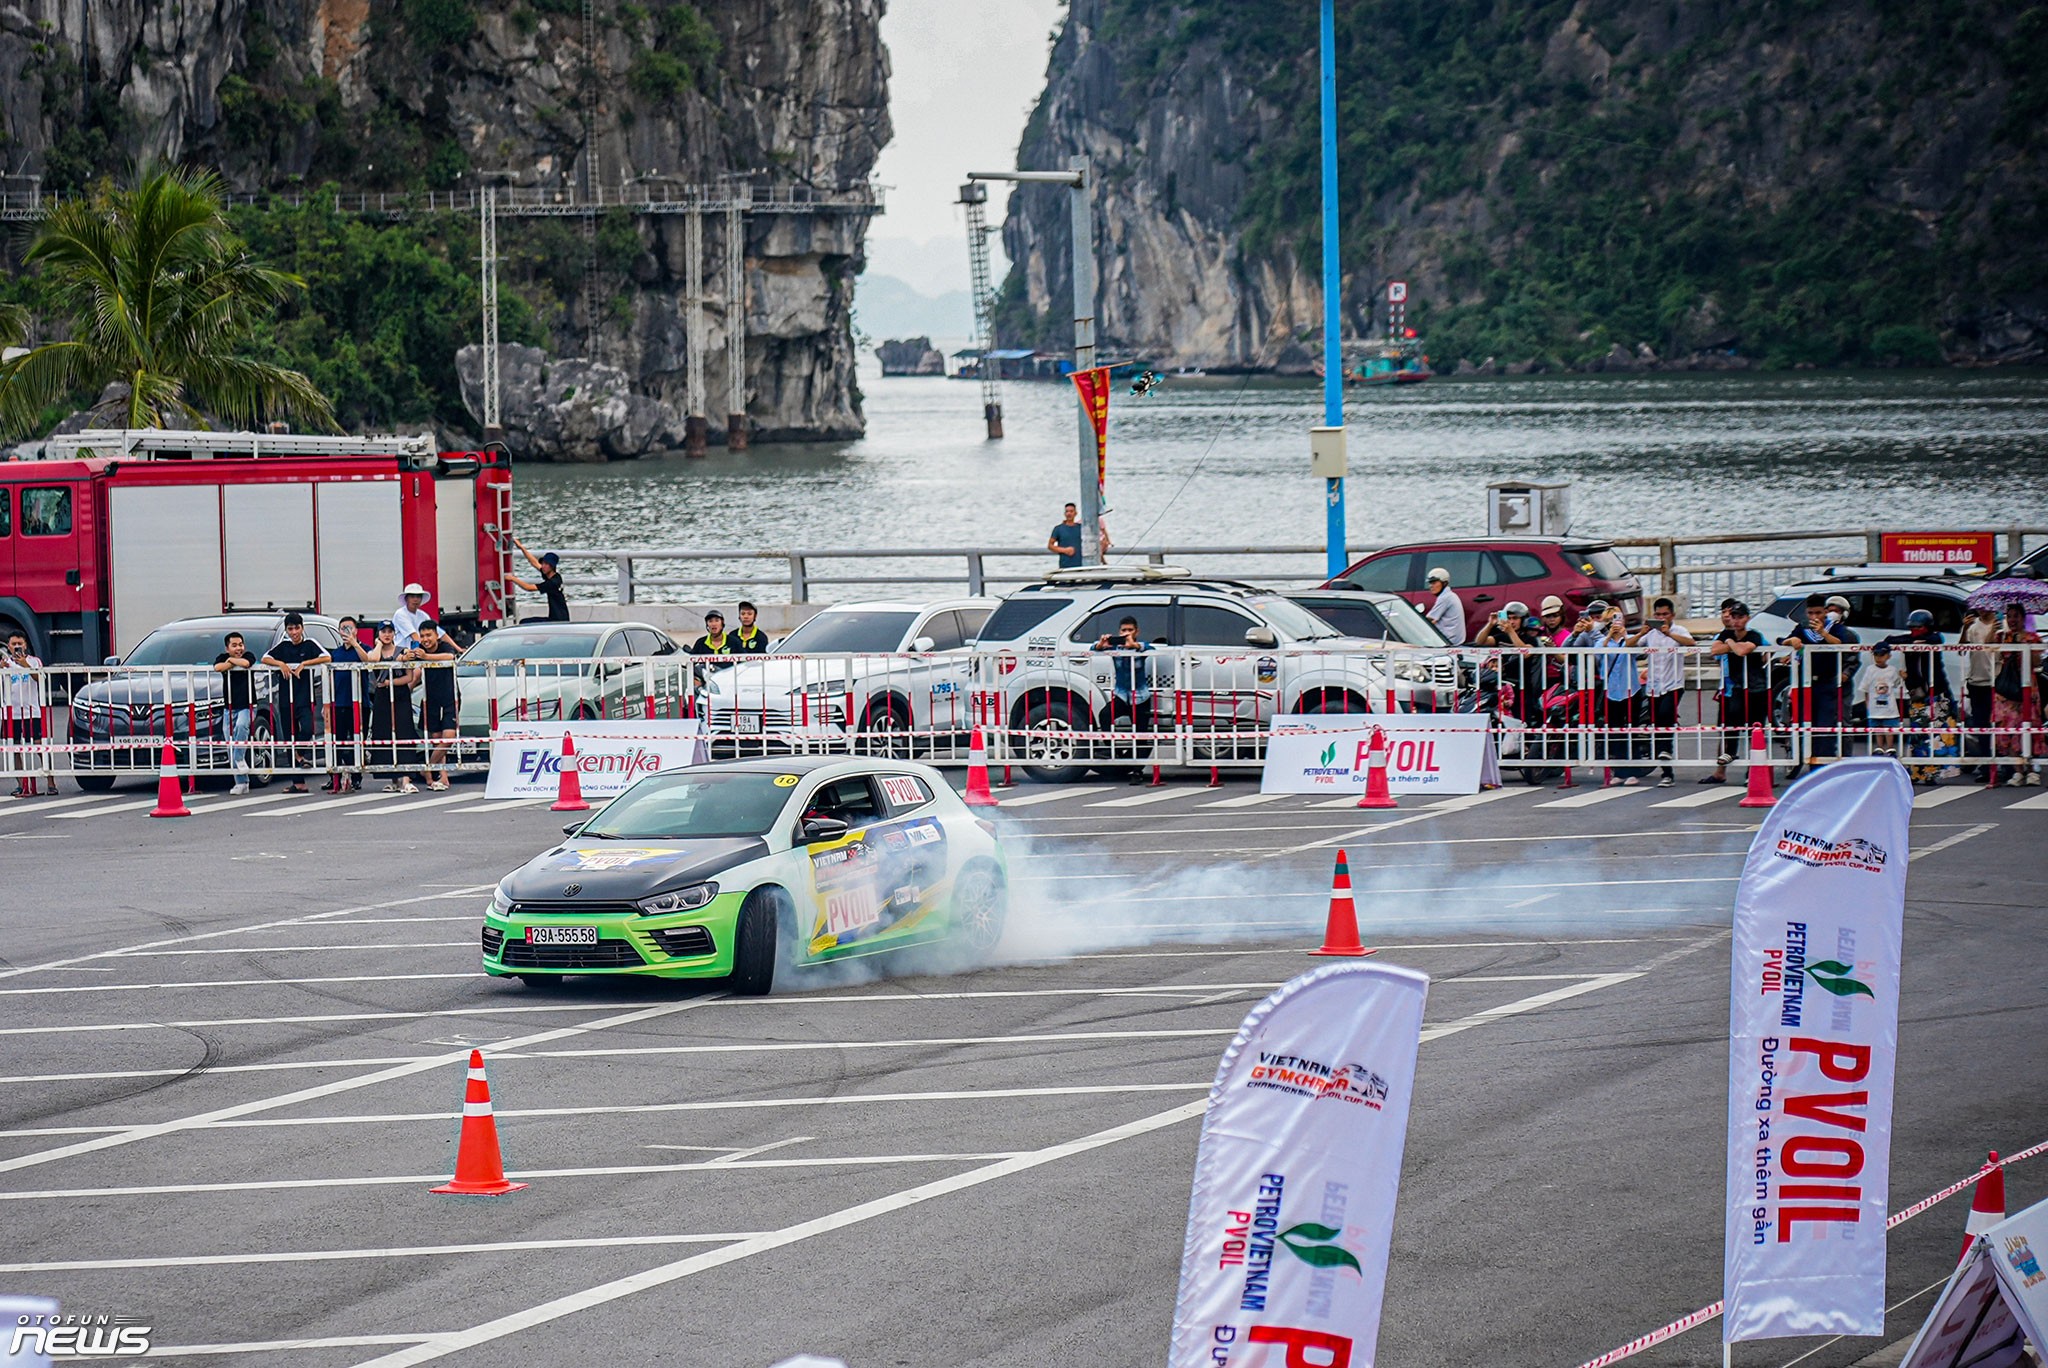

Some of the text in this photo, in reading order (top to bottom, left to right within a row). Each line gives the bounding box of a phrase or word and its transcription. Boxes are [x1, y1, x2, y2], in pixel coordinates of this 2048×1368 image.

[1903, 548, 1973, 561] THÔNG BÁO
[778, 777, 796, 785] 10
[1303, 768, 1350, 776] PETROVIETNAM
[1315, 776, 1336, 784] PVOIL
[884, 775, 923, 804] PVOIL
[1777, 840, 1852, 862] GYMKHANA
[1783, 829, 1833, 851] VIETNAM
[813, 850, 848, 868] VIETNAM
[828, 890, 876, 933] PVOIL
[533, 927, 596, 943] 29A-555.58
[1761, 949, 1783, 996] PVOIL
[1781, 922, 1806, 1027] PETROVIETNAM
[1260, 1051, 1331, 1077] VIETNAM
[1343, 1095, 1363, 1105] CUP
[1752, 1036, 1780, 1246] Đường xa thêm gần
[1777, 1036, 1872, 1243] PVOIL
[1219, 1210, 1251, 1271] PVOIL
[1240, 1173, 1285, 1312] PETROVIETNAM
